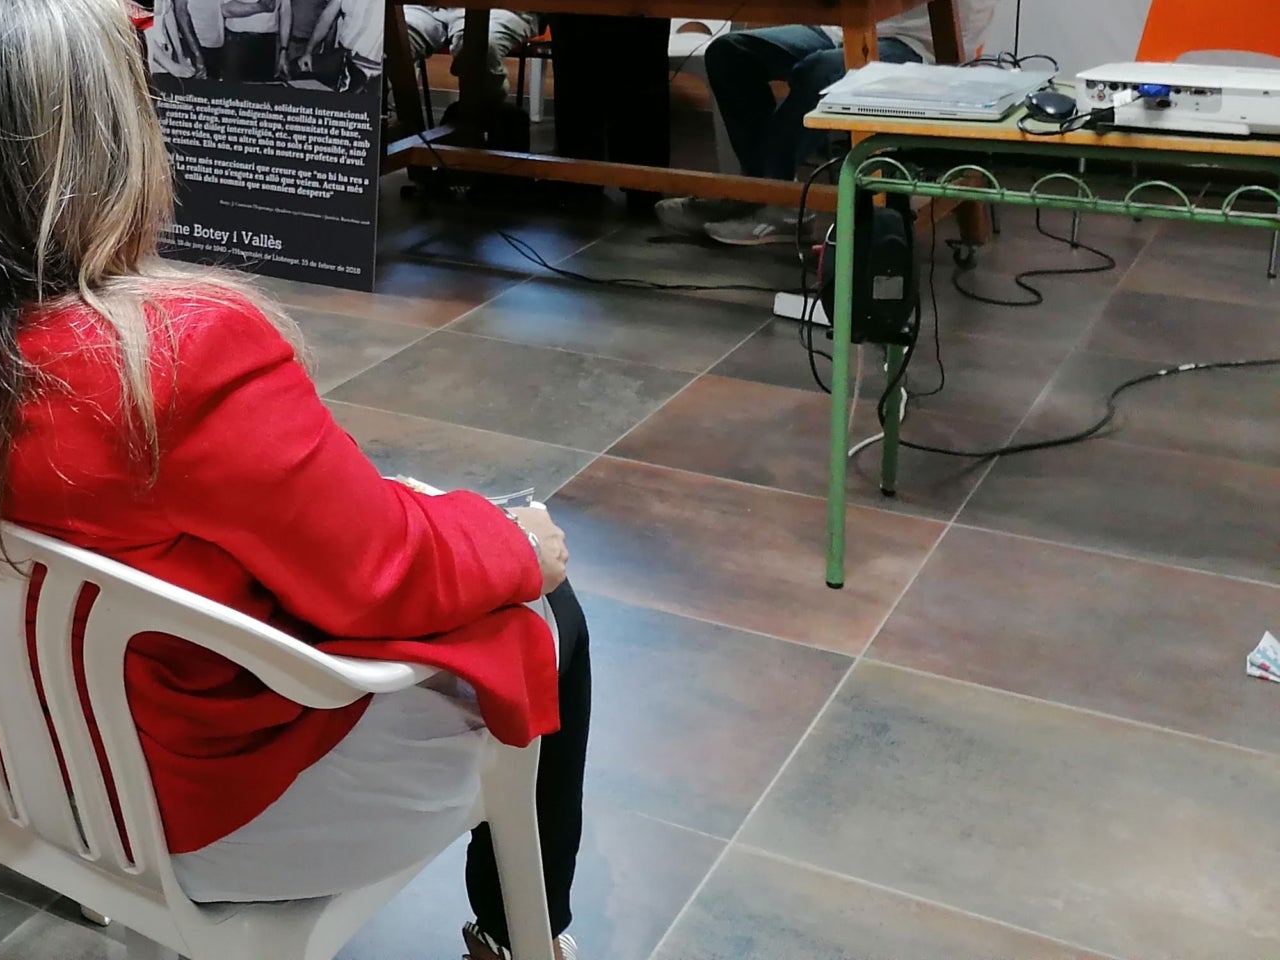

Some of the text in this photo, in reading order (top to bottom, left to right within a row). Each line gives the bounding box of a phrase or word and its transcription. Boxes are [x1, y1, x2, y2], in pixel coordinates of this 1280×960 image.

[166, 111, 189, 119] contra
[221, 117, 258, 127] moviment
[285, 123, 328, 135] comunitats
[330, 127, 339, 135] de
[341, 129, 361, 139] base,
[274, 105, 313, 114] solidaritat
[315, 107, 369, 121] internacional,
[287, 115, 316, 124] acollida
[324, 118, 373, 131] l'immigrant,
[194, 121, 202, 129] de
[293, 134, 306, 144] que
[309, 136, 351, 146] proclamen,
[353, 140, 370, 148] amb
[213, 134, 226, 142] que
[239, 135, 256, 144] altre
[258, 137, 274, 146] món
[288, 141, 302, 150] sols
[304, 142, 312, 150] és
[314, 144, 348, 155] possible,
[349, 149, 366, 157] sinó
[203, 139, 216, 148] Ells
[218, 141, 232, 151] són,
[263, 147, 274, 155] els
[276, 150, 304, 158] nostres
[306, 152, 338, 163] profetes
[339, 156, 365, 166] d'avui.
[184, 172, 202, 181] enllà
[220, 177, 245, 186] somnis
[247, 181, 260, 190] que
[262, 183, 296, 194] somniem
[186, 165, 212, 174] realitat
[214, 167, 223, 175] no
[225, 169, 253, 180] s'esgota
[266, 172, 279, 182] allò
[281, 176, 295, 186] que
[296, 178, 321, 188] veiem.
[323, 181, 345, 191] Actua
[347, 184, 363, 194] més
[198, 156, 213, 165] més
[214, 159, 255, 170] reaccionari
[256, 164, 270, 173] que
[271, 165, 296, 176] creure
[298, 169, 312, 178] que
[328, 172, 336, 180] hi
[339, 173, 348, 182] ha
[349, 176, 362, 184] res
[194, 223, 230, 244] Botey
[233, 232, 237, 242] i
[241, 230, 282, 250] Vallès
